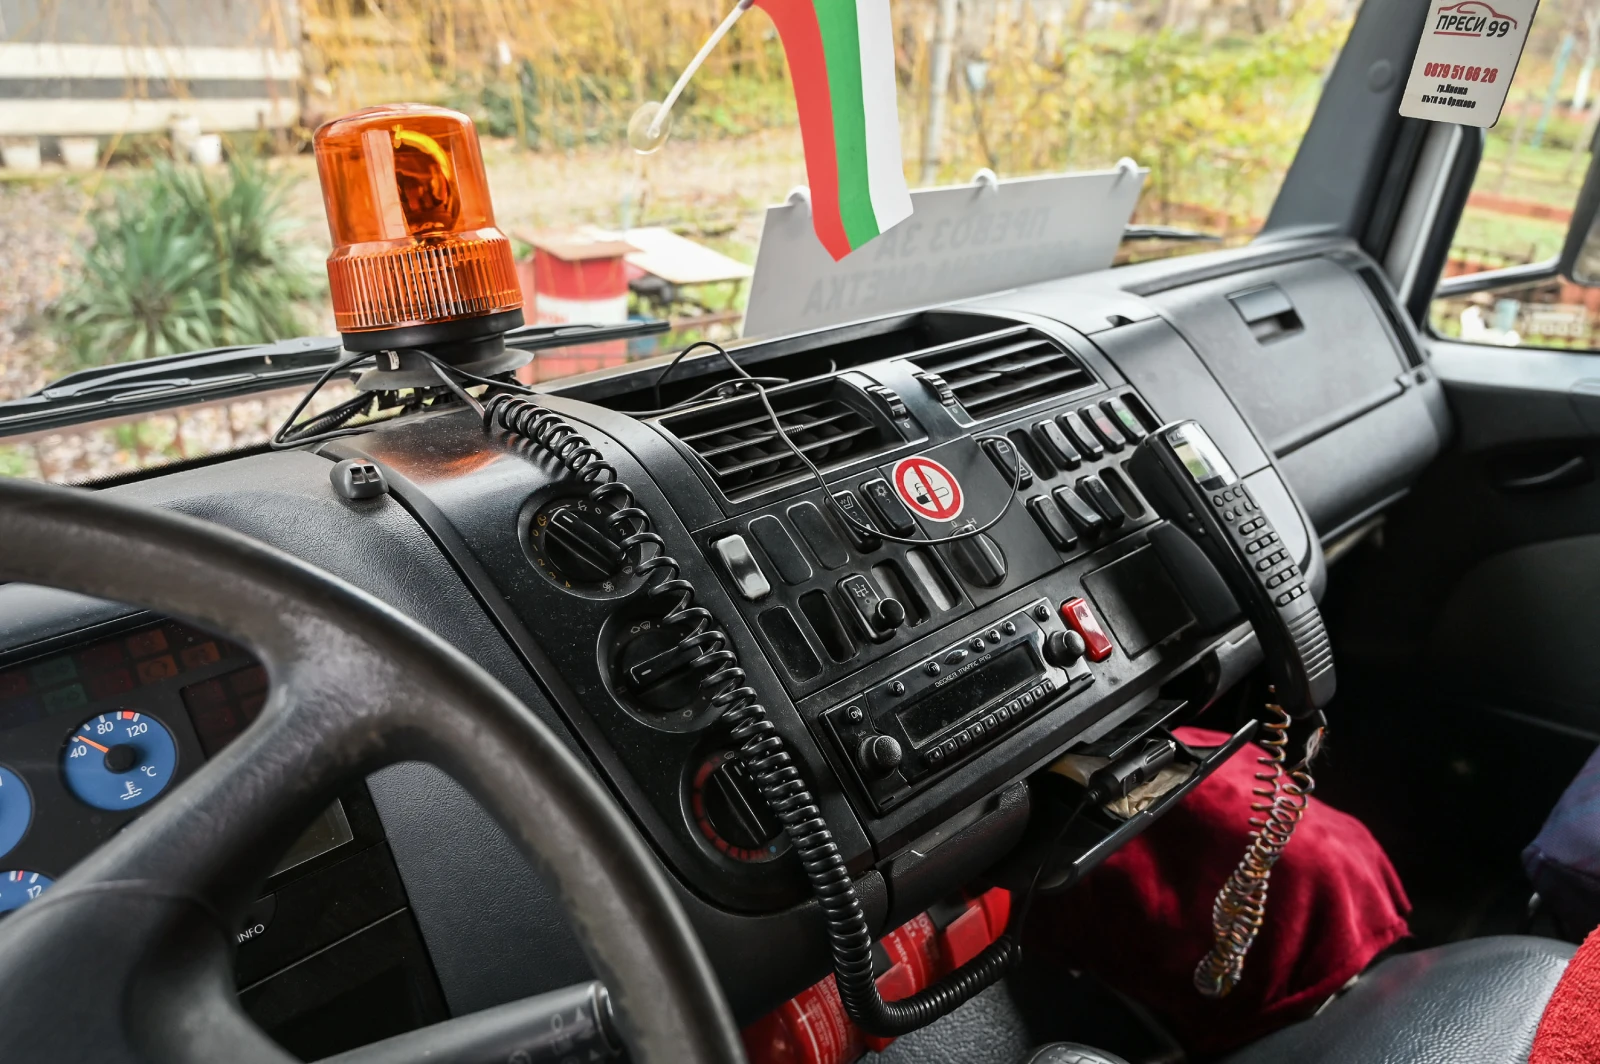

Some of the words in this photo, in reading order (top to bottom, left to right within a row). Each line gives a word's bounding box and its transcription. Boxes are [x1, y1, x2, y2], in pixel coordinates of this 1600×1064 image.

[1436, 15, 1487, 32] ПРЕСИ
[1486, 21, 1510, 37] 99
[1424, 62, 1450, 78] 0879
[1450, 65, 1466, 80] 51
[97, 721, 114, 735] 80
[126, 722, 148, 738] 120
[70, 745, 87, 758] 40
[236, 924, 265, 943] INFO
